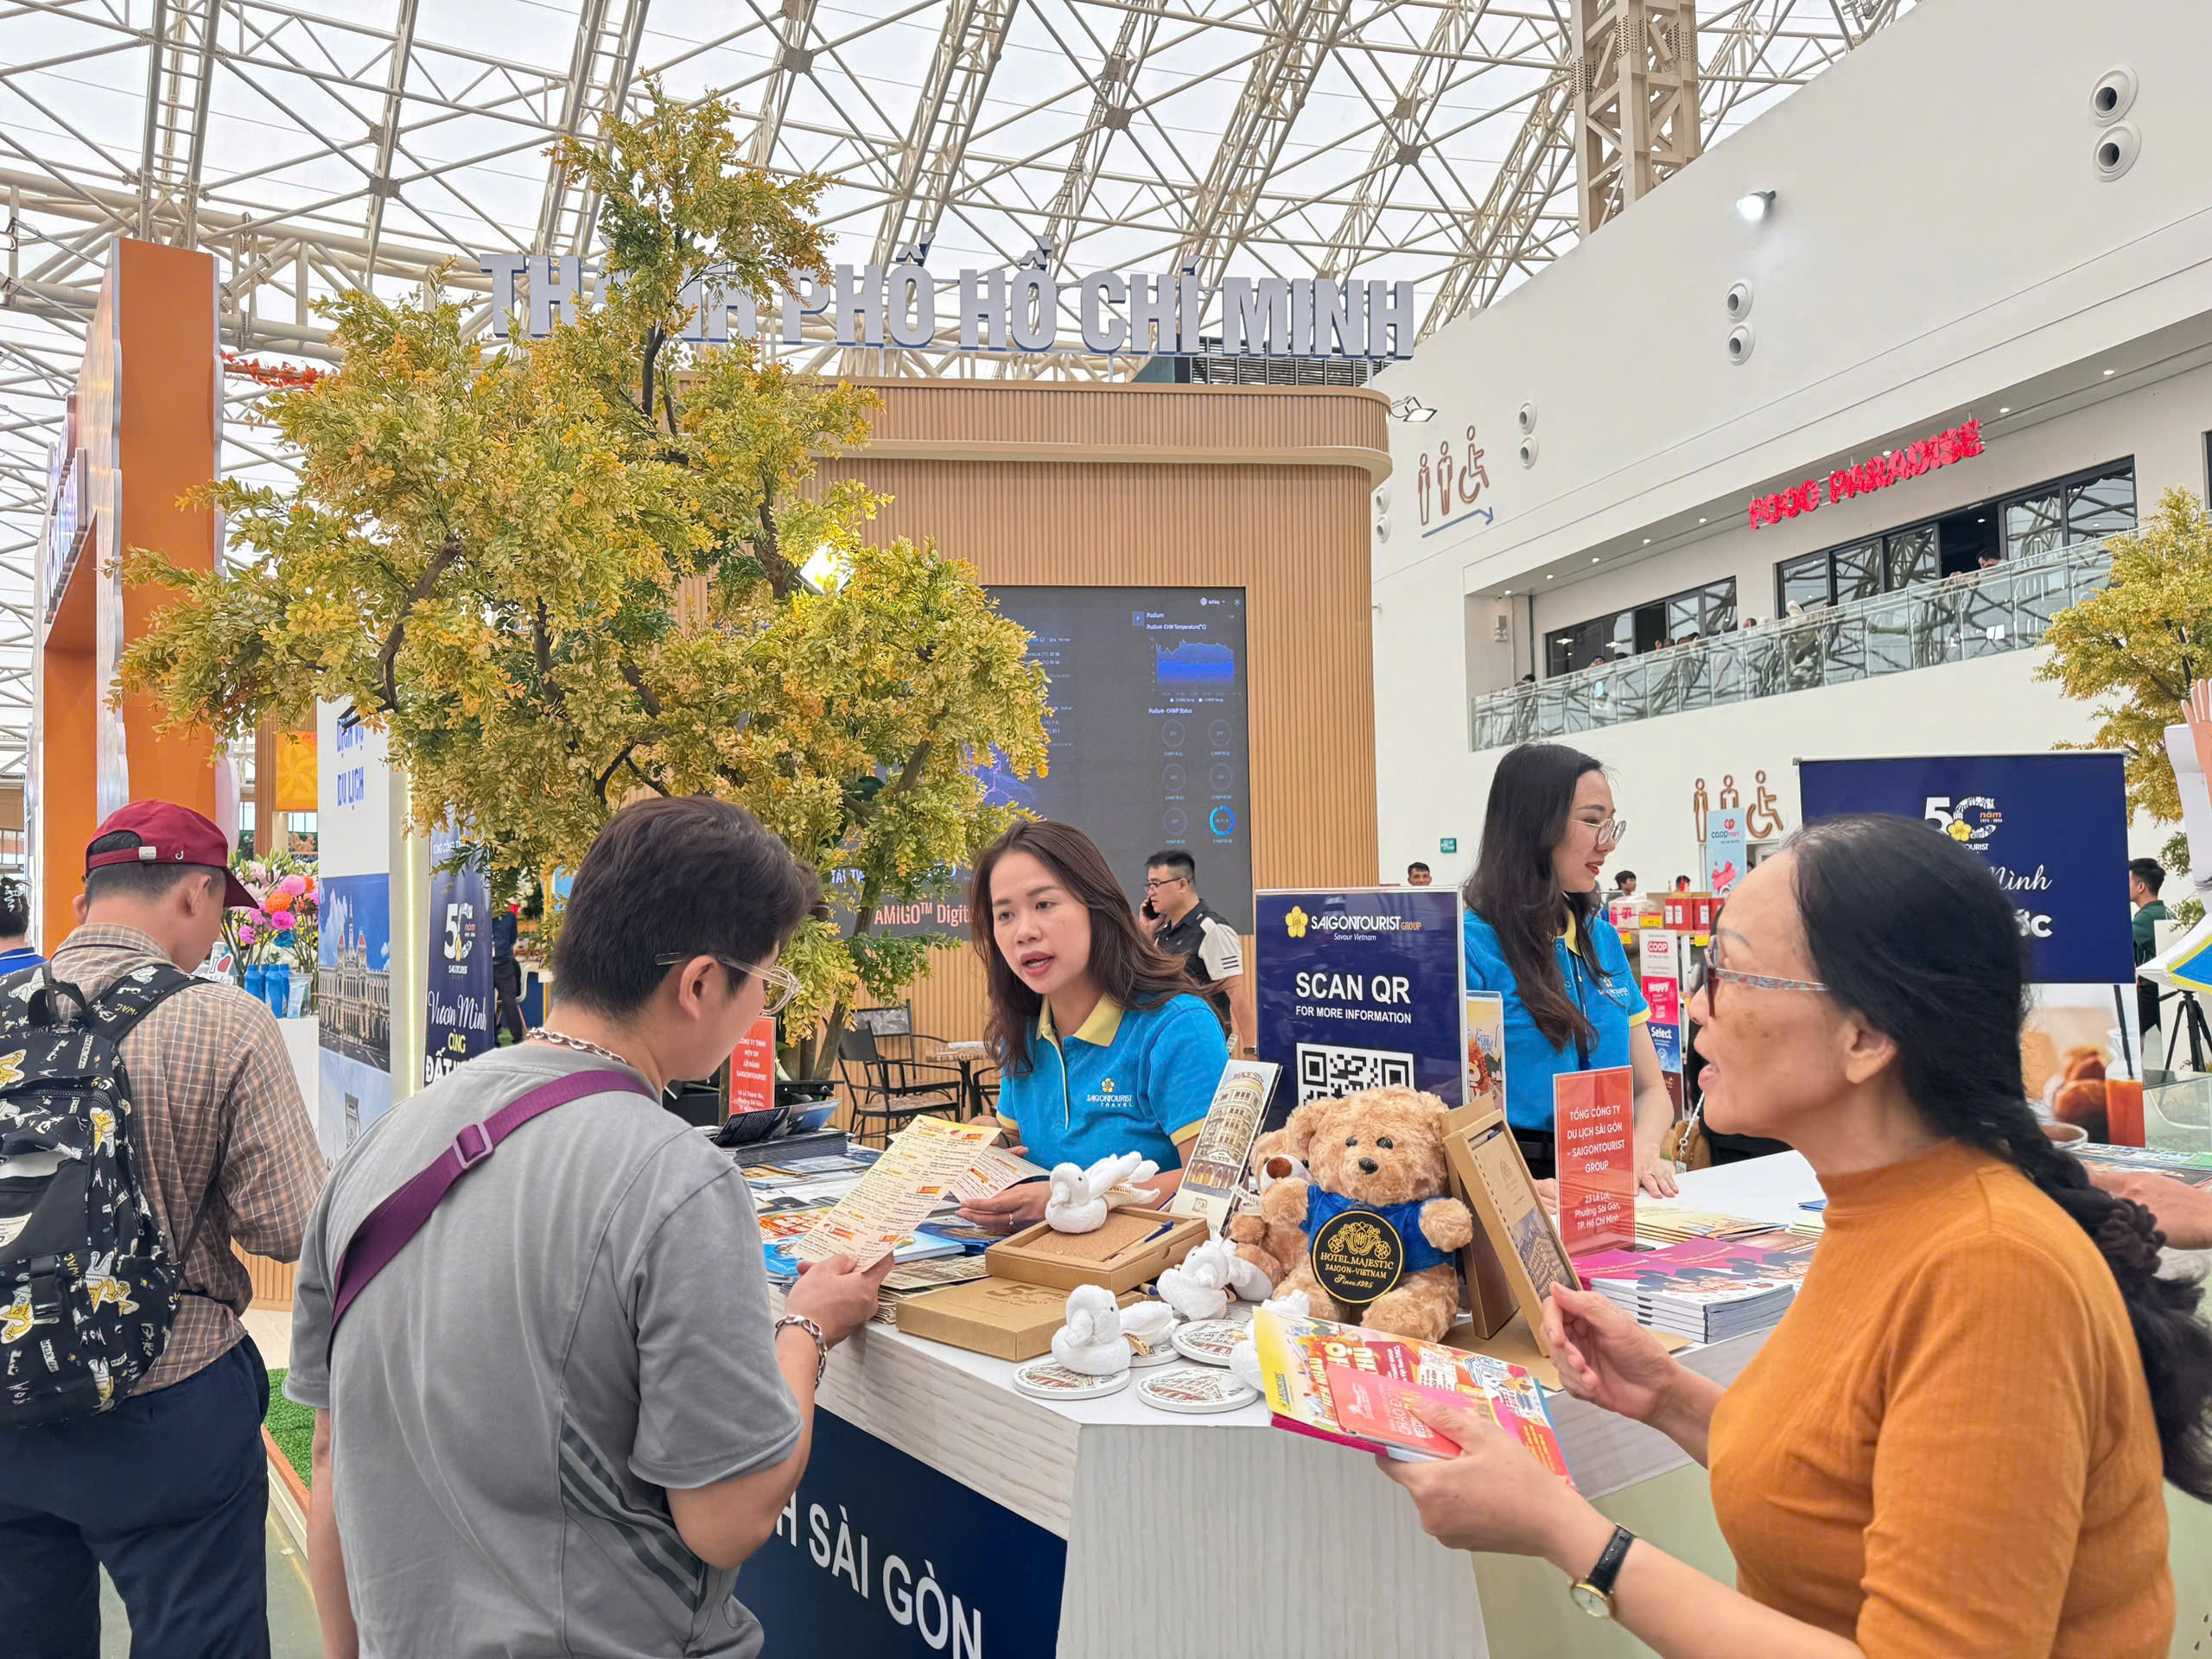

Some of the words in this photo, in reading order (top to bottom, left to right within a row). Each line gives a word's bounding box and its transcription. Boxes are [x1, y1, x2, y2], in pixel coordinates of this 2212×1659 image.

[480, 242, 758, 342] THH
[781, 232, 936, 347] PHỐ
[959, 234, 1057, 353] HỒ
[1080, 255, 1200, 356] CHÍ
[1222, 276, 1414, 360] MINH
[1749, 479, 1821, 531] FOOD
[1828, 419, 1985, 504] PARADISE
[338, 772, 346, 807] DU
[348, 766, 364, 810] LỊCH
[937, 904, 969, 927] Digit
[1311, 915, 1401, 931] SAIGONTOURIST
[1401, 921, 1421, 931] GROUP
[1333, 932, 1352, 941] Savour
[1354, 932, 1376, 941] Vietnam
[1295, 971, 1363, 1001] SCAN
[1371, 975, 1412, 1005] QR
[457, 994, 486, 1032] Mình
[1296, 1005, 1314, 1017] FOR
[1316, 1007, 1344, 1020] MORE
[1345, 1009, 1412, 1024] INFORMATION
[1651, 1027, 1672, 1039] Select
[1086, 1094, 1133, 1103] SAIGONTOURIST
[1570, 1104, 1589, 1122] TỔNG
[1591, 1105, 1611, 1118] CÔNG
[1612, 1104, 1621, 1116] TY
[1567, 1129, 1578, 1140] DU
[1579, 1126, 1594, 1141] LỊCH
[1595, 1123, 1606, 1135] SÀI
[1607, 1122, 1623, 1135] GÒN
[1572, 1139, 1625, 1158] SAIGONTOURIST
[1585, 1161, 1609, 1173] GROUP
[1320, 1251, 1350, 1264] HOTEL
[1351, 1256, 1394, 1270] MAJESTIC
[809, 1503, 868, 1599] SÀI
[883, 1555, 982, 1659] GÒN
